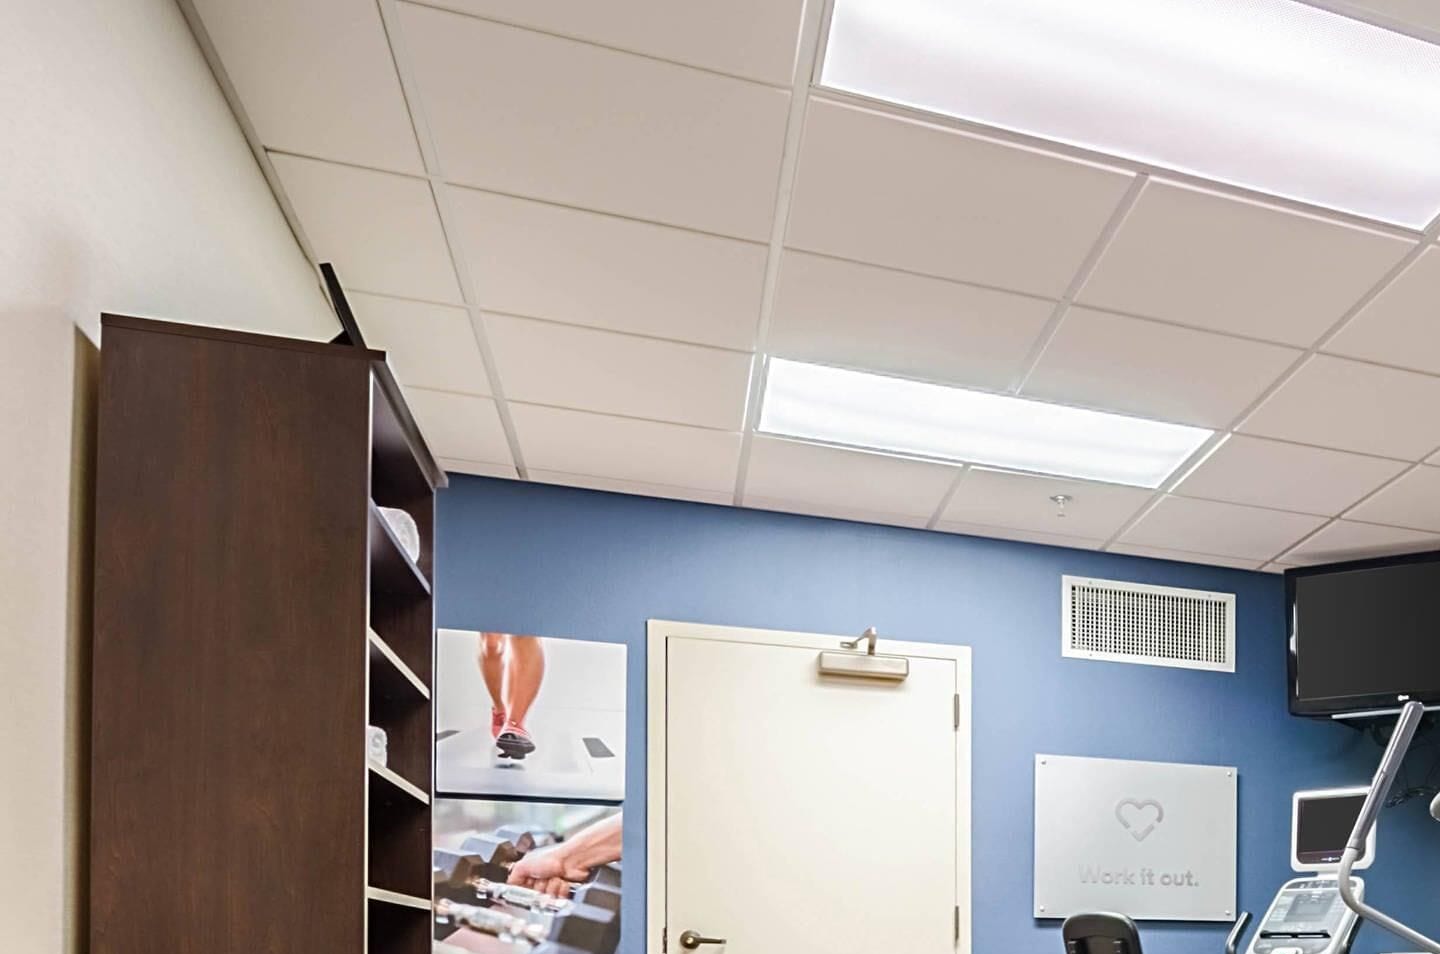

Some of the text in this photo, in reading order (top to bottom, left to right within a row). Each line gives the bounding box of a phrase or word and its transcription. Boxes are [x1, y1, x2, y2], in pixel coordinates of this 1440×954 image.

[1079, 864, 1200, 888] Work it out.
